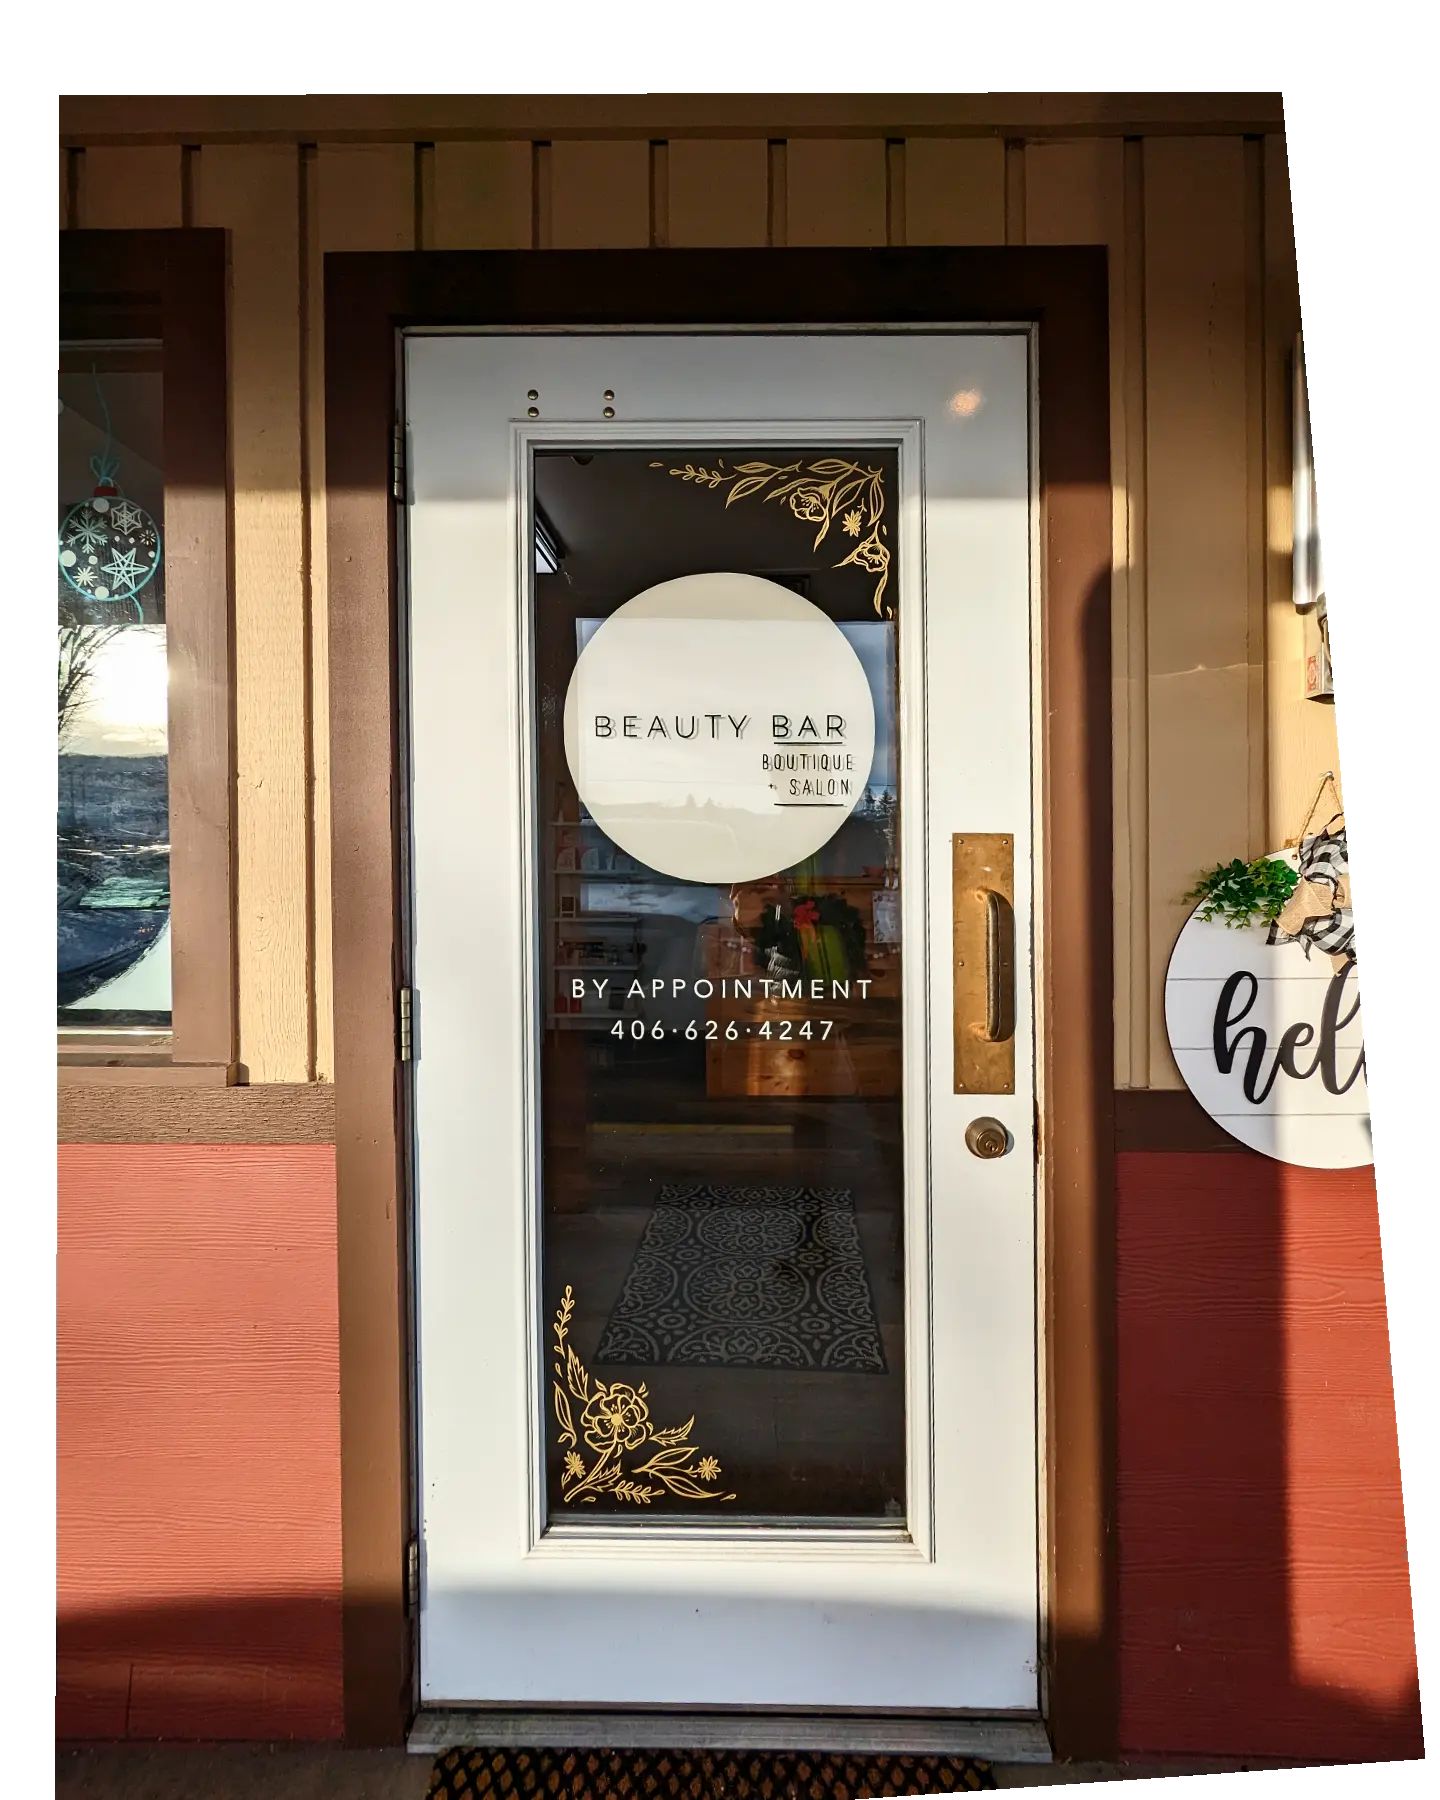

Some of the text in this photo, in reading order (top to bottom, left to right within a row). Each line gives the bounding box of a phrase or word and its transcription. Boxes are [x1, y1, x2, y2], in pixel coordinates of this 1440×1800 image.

[594, 714, 845, 738] BEAUTY BAR
[762, 753, 853, 771] BOUTIQUE
[789, 778, 850, 796] SALON
[571, 979, 873, 1000] BY APPOINTMENT
[1213, 961, 1368, 1105] hel
